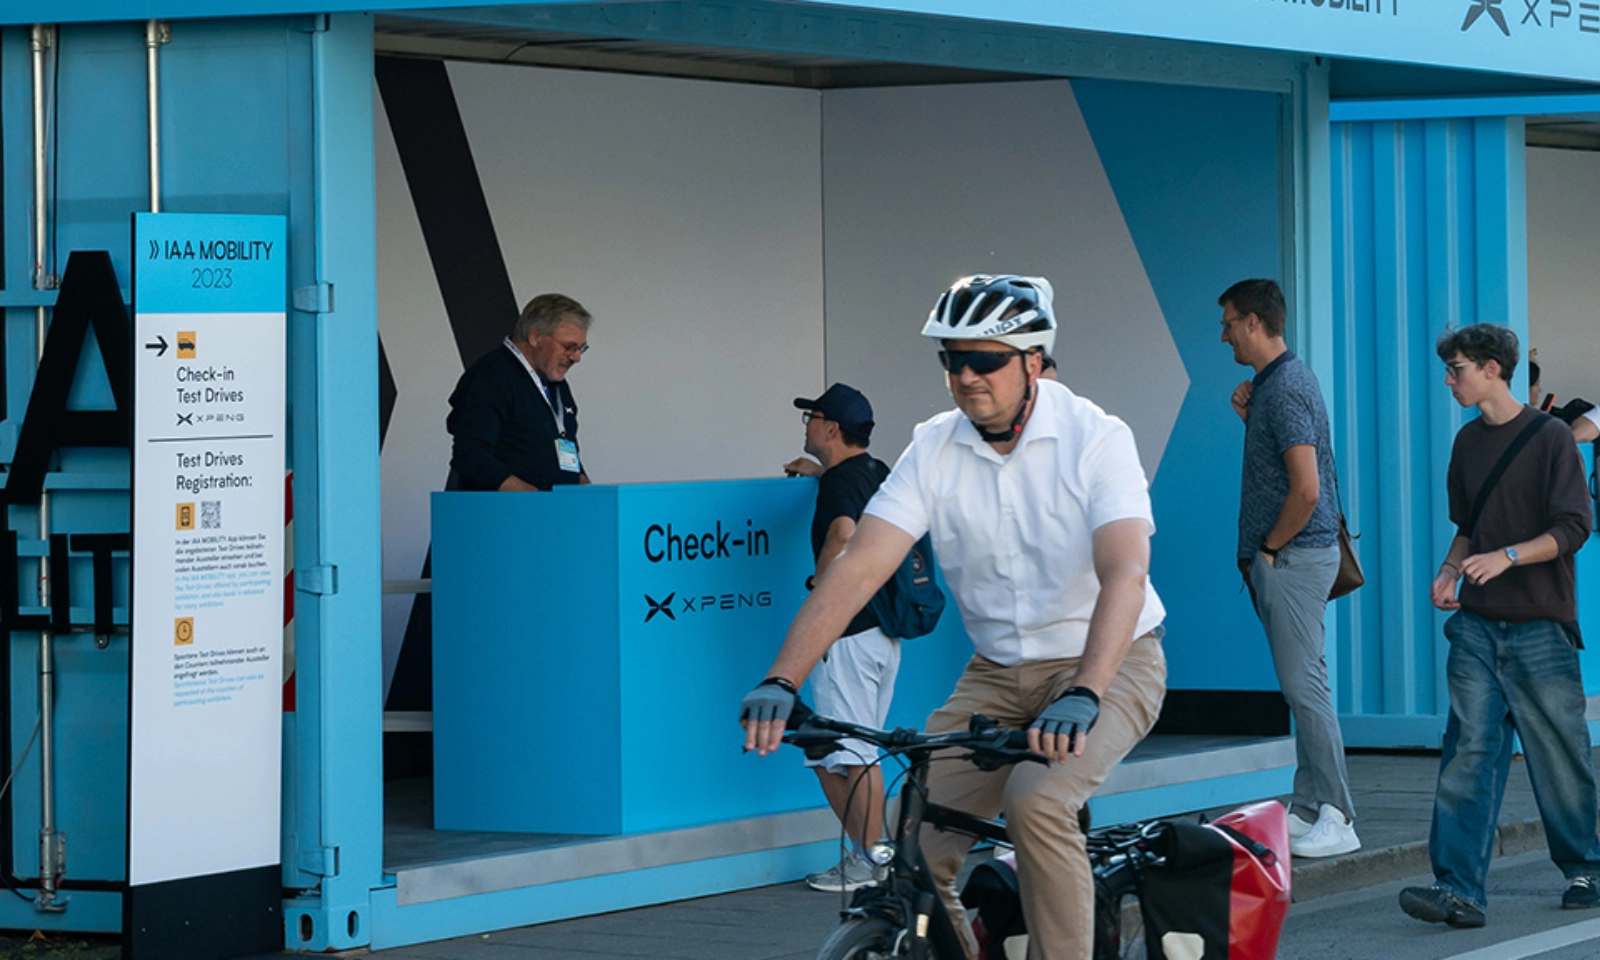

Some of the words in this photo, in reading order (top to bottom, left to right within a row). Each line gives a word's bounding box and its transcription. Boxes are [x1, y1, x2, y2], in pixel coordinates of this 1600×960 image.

[164, 240, 196, 260] IAA
[199, 240, 274, 260] MOBILITY
[191, 267, 233, 289] 2023
[176, 366, 235, 382] Check-in
[176, 388, 201, 403] Test
[204, 387, 244, 403] Drives
[196, 413, 245, 422] XPENG
[176, 452, 201, 468] Test
[204, 451, 244, 467] Drives
[176, 473, 253, 494] Registration:
[644, 519, 769, 563] Check-in
[682, 591, 772, 613] XPENG
